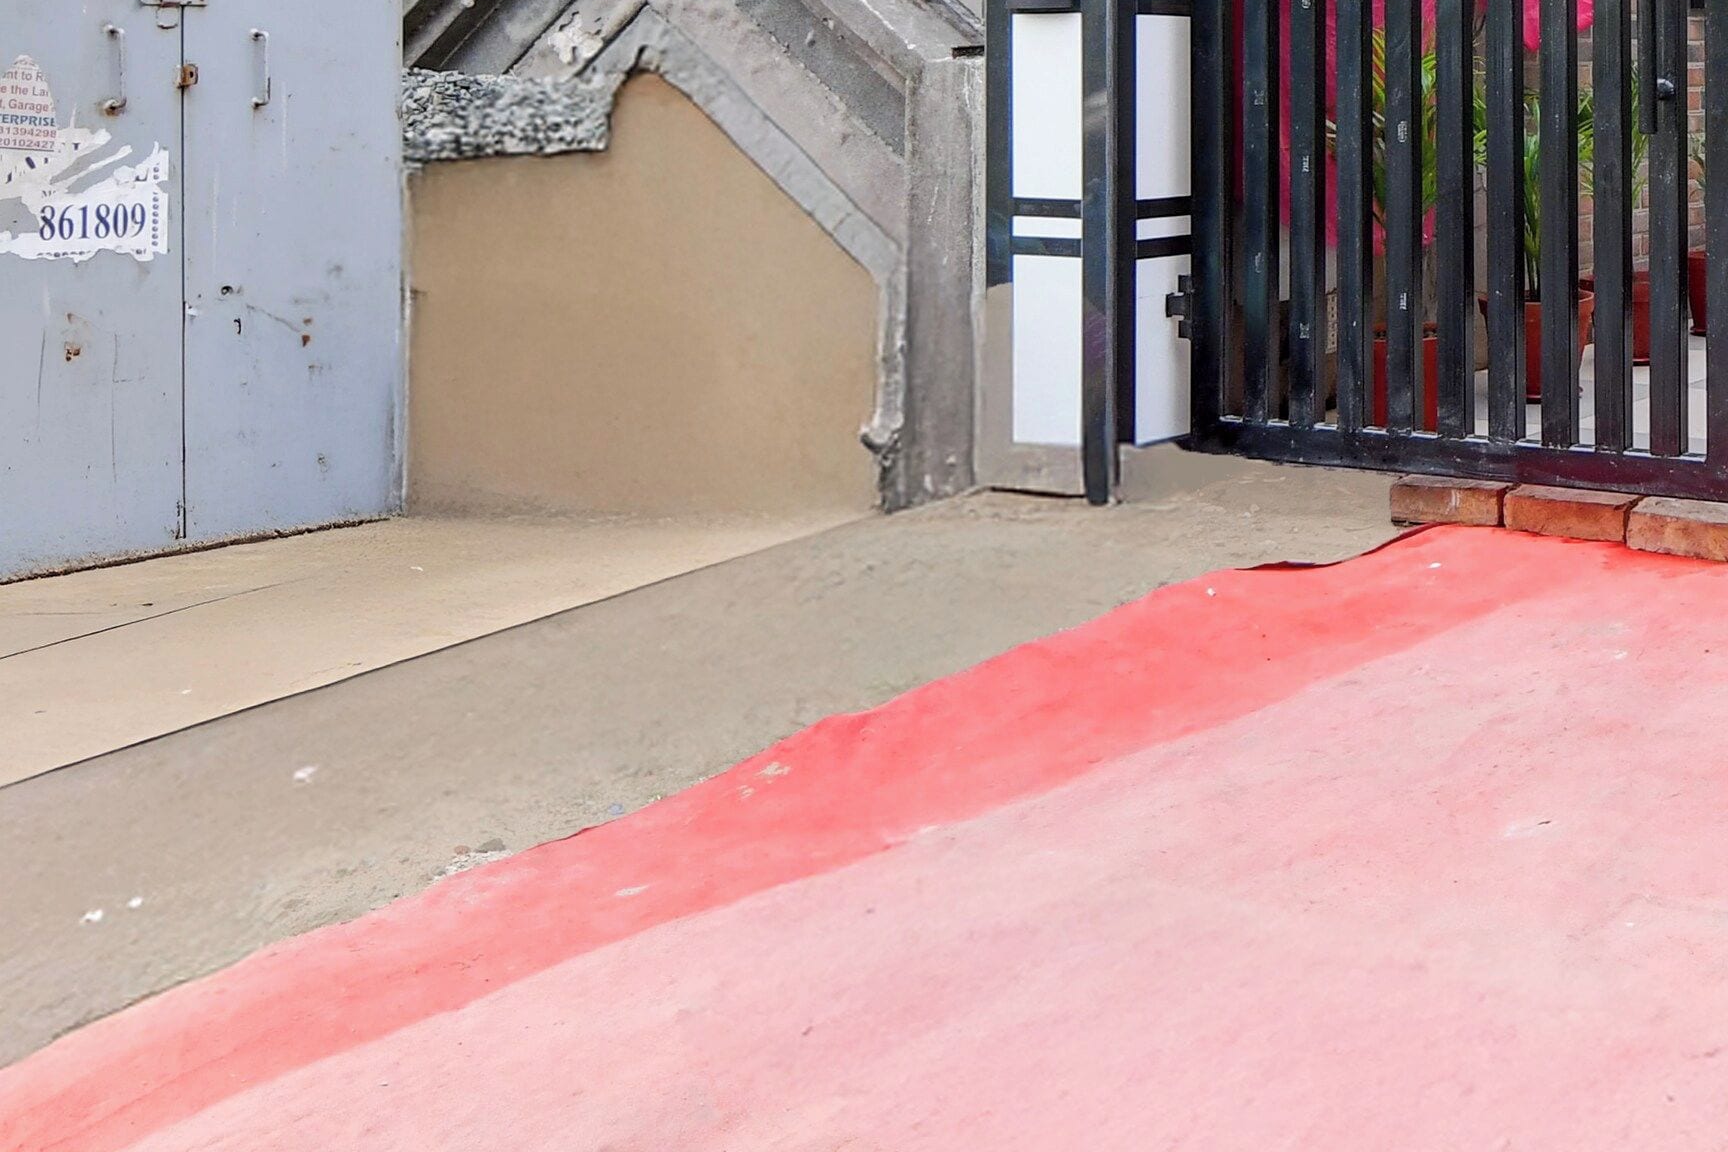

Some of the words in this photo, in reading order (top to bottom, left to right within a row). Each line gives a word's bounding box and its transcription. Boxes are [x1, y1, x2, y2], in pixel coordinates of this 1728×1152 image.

[21, 71, 33, 81] to
[11, 84, 29, 96] the
[39, 203, 146, 241] 861809
